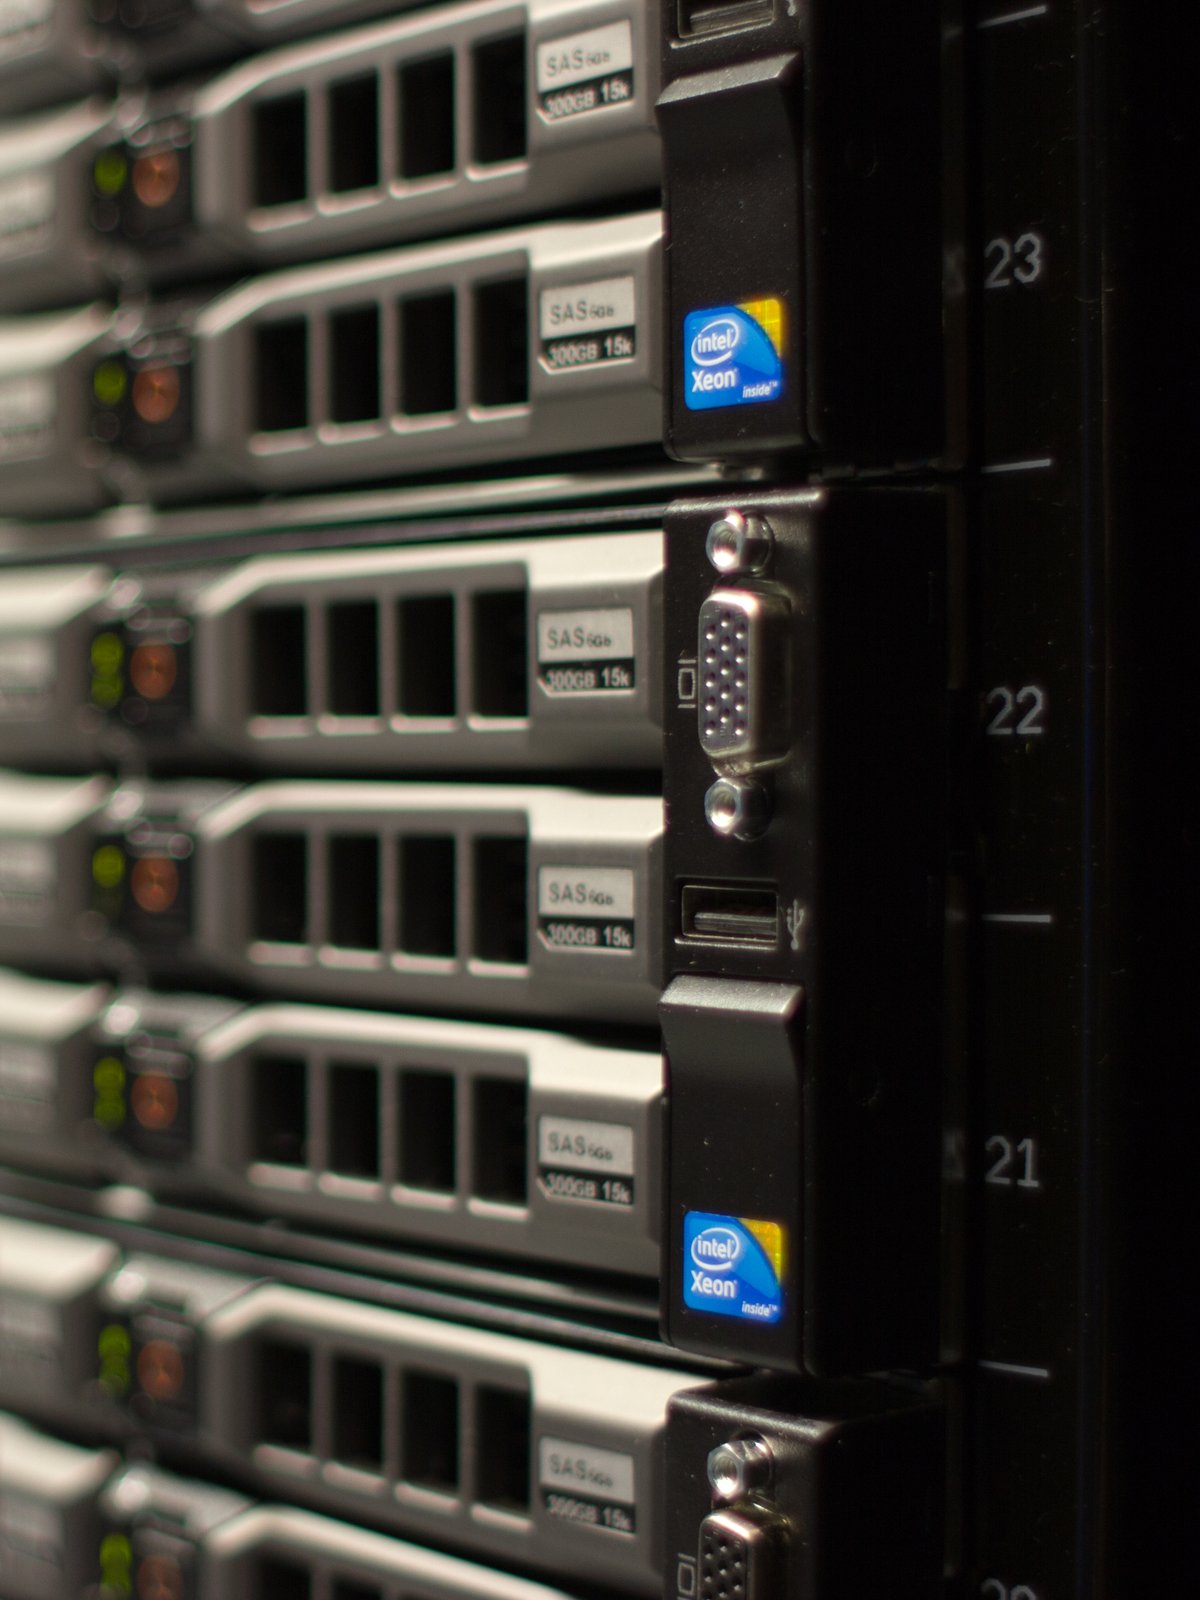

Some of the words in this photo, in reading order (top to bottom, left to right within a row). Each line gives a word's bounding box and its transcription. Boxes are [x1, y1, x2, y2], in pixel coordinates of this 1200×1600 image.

[546, 48, 583, 77] SAS
[984, 232, 1043, 288] 23
[550, 299, 587, 325] SAS
[548, 341, 598, 367] 300GB
[697, 328, 732, 354] intel
[691, 369, 736, 392] Xeon
[547, 626, 585, 650] SAS
[546, 668, 596, 690] 300GB
[601, 665, 630, 687] 15k
[985, 684, 1044, 736] 22
[549, 882, 587, 904] SAS
[547, 922, 597, 944] 300GB
[603, 925, 632, 947] 15k
[548, 1132, 586, 1156] SAS
[984, 1135, 1039, 1188] 21
[697, 1234, 732, 1260] intel
[690, 1270, 736, 1298] Xeon
[550, 1452, 587, 1480] SAS
